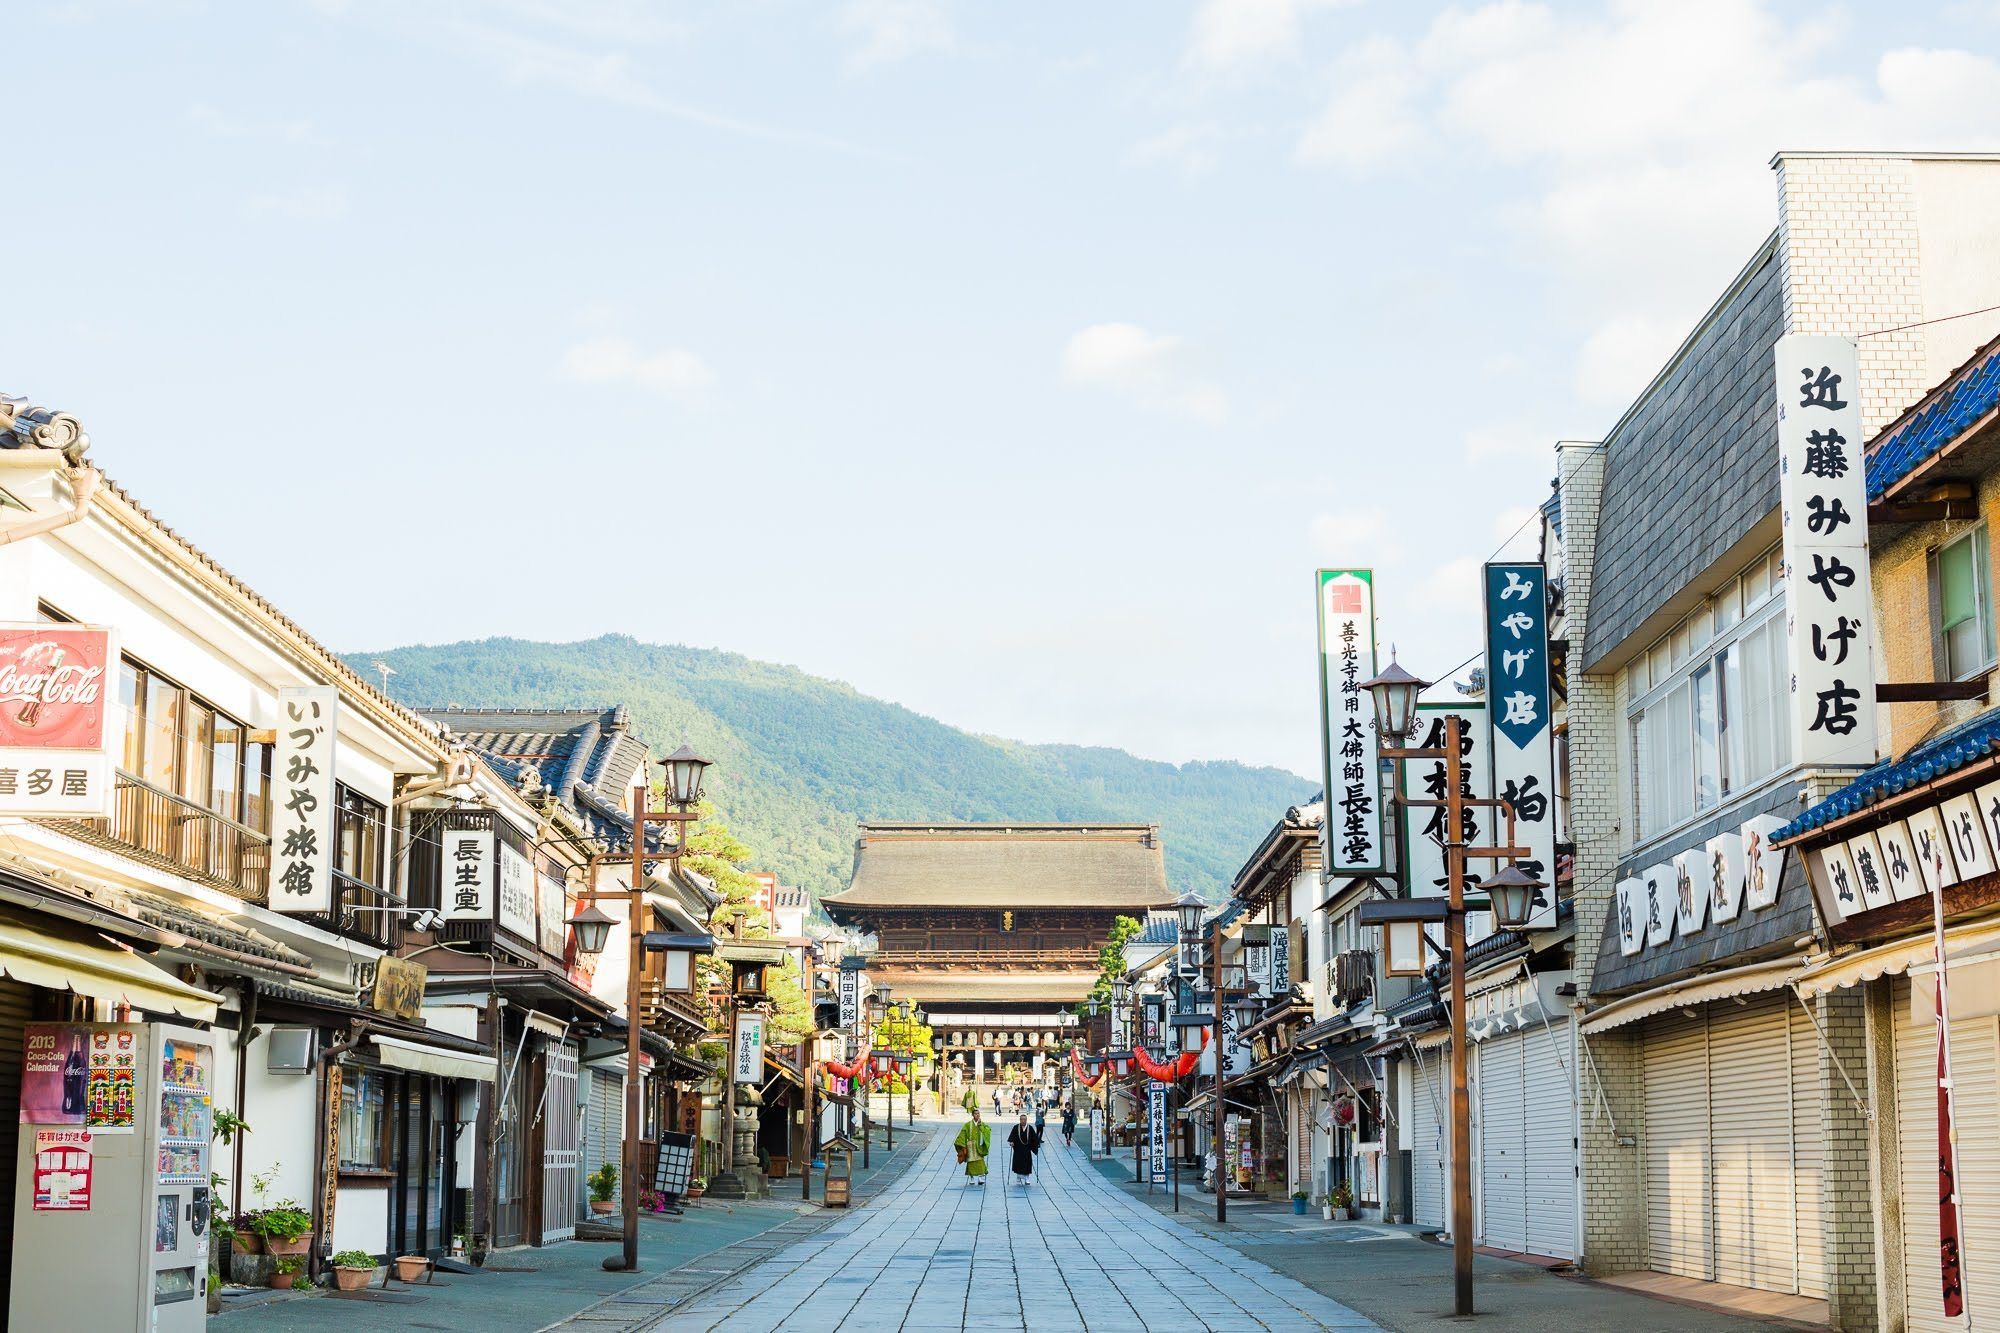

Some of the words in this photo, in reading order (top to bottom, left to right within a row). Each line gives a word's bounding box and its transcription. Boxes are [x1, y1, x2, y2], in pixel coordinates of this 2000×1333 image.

[1800, 366, 1861, 735] 近藤みやげ店
[1500, 571, 1538, 725] みやげ店
[279, 701, 323, 896] いづみや旅館
[453, 839, 484, 912] 長生堂
[27, 1051, 65, 1061] Coca-Cola
[28, 1035, 56, 1049] 2013
[26, 1063, 60, 1073] Calendar
[38, 1131, 80, 1142] 年賀はがき
